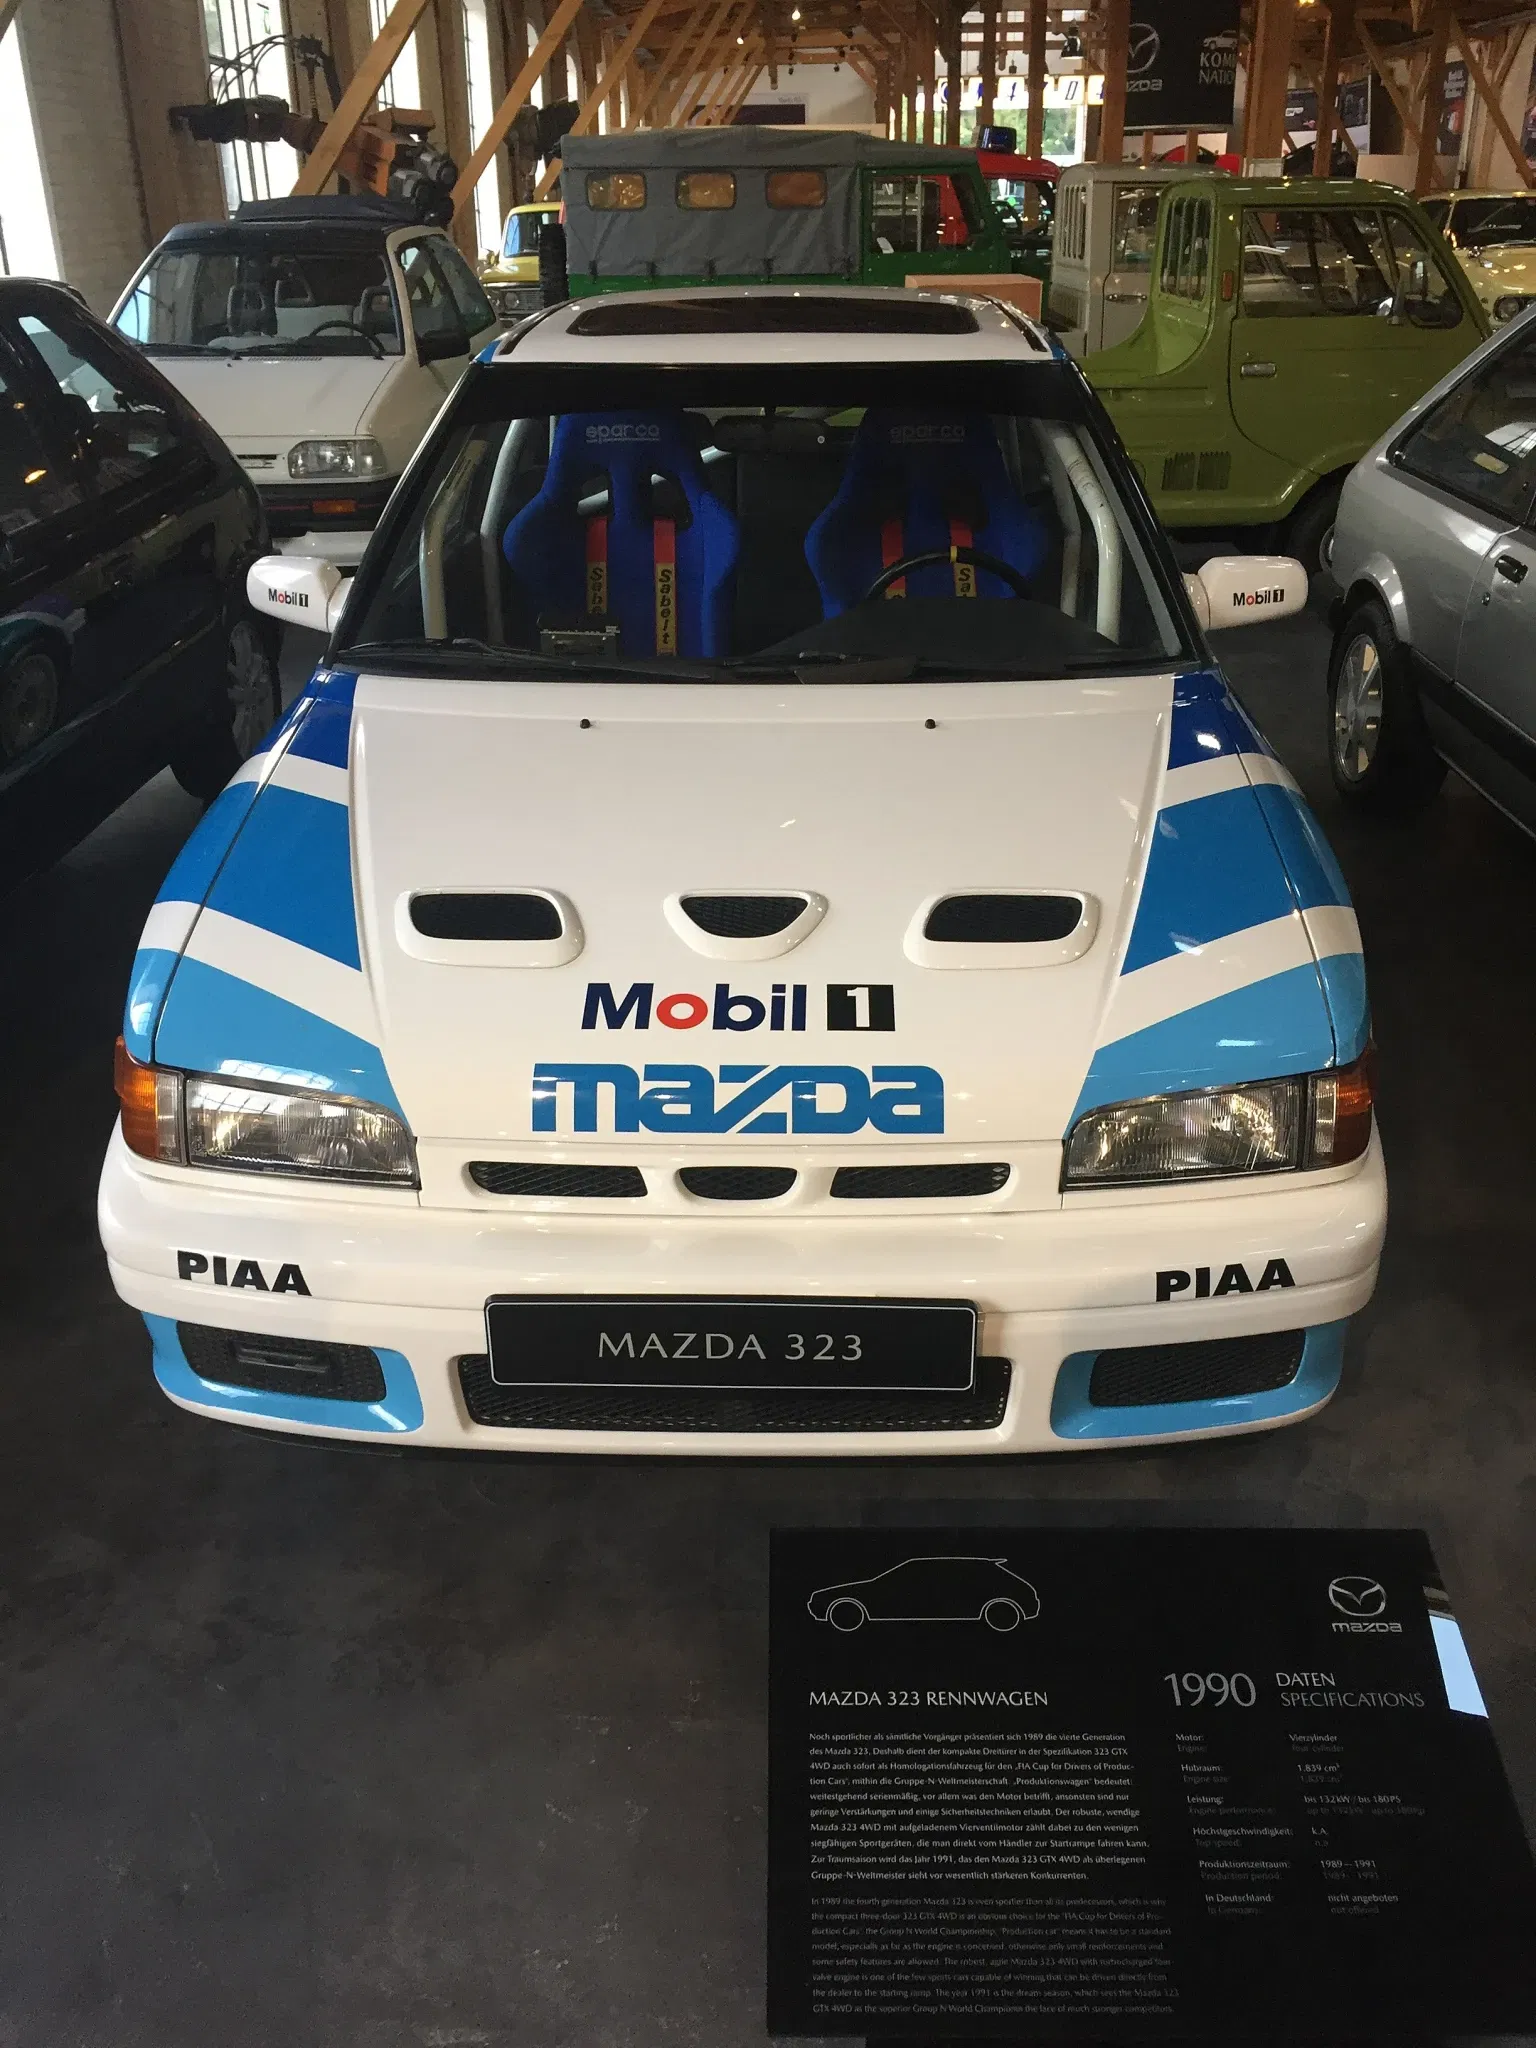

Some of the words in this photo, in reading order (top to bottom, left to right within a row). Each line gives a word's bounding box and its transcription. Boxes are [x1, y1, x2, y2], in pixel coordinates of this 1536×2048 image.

[585, 424, 660, 442] sparco
[889, 425, 965, 443] sparco
[268, 588, 297, 606] Mobil
[299, 594, 309, 607] 1
[1233, 590, 1271, 606] Mobil
[1273, 589, 1284, 602] 1
[658, 569, 673, 645] Sabelt
[581, 982, 807, 1032] Mobil
[826, 984, 896, 1032] 1
[177, 1250, 312, 1296] PIAA
[1155, 1257, 1297, 1302] PIAA
[598, 1332, 766, 1359] MAZDA
[785, 1333, 861, 1360] 323
[1275, 1672, 1335, 1686] DATEN
[1164, 1672, 1256, 1706] 1990
[809, 1691, 881, 1705] MAZDA
[887, 1691, 919, 1705] 323
[926, 1691, 1047, 1705] RENNWAGEN
[1280, 1692, 1424, 1707] SPECIFICATIONS
[831, 1733, 871, 1741] sportlicher
[873, 1732, 884, 1740] als
[885, 1732, 921, 1740] sämtliche
[922, 1733, 961, 1742] Vorgänger
[963, 1732, 1004, 1742] präsentiert
[1023, 1732, 1043, 1740] 1989
[1081, 1732, 1125, 1741] Generation
[809, 1747, 823, 1755] des
[824, 1747, 851, 1755] Mazda
[872, 1747, 904, 1755] Deshalb
[906, 1747, 925, 1755] dient
[927, 1747, 940, 1755] der
[942, 1747, 981, 1756] kompakte
[982, 1747, 1017, 1755] Dreitürer
[1018, 1747, 1026, 1755] in
[1027, 1747, 1040, 1755] der
[1042, 1747, 1092, 1756] Spezifikation
[1094, 1747, 1109, 1755] 323
[1111, 1747, 1127, 1755] GTX
[809, 1761, 830, 1769] 4WD
[832, 1762, 851, 1770] auch
[984, 1761, 995, 1770] für
[997, 1762, 1012, 1770] den
[1032, 1762, 1049, 1771] Cup
[1064, 1762, 1091, 1770] Drivers
[1093, 1762, 1101, 1770] of
[879, 1777, 892, 1785] die
[809, 1792, 867, 1802] weitestgehend
[869, 1791, 920, 1802] serienmäßig,
[937, 1792, 959, 1800] allem
[978, 1792, 994, 1800] den
[996, 1792, 1021, 1800] Motor
[1097, 1792, 1114, 1800] sind
[810, 1807, 839, 1817] geringe
[840, 1807, 896, 1818] Verstärkungen
[897, 1807, 913, 1815] und
[915, 1808, 939, 1817] einige
[1055, 1807, 1070, 1815] Der
[1072, 1808, 1104, 1816] robuste,
[1105, 1808, 1139, 1818] wendige
[810, 1823, 838, 1831] Mazda
[841, 1823, 856, 1831] 323
[859, 1823, 881, 1831] 4WD
[899, 1822, 957, 1833] aufgeladenem
[1025, 1823, 1045, 1831] zählt
[1047, 1823, 1071, 1831] dabei
[1085, 1823, 1101, 1831] den
[1103, 1825, 1138, 1833] wenigen
[810, 1838, 856, 1849] siegfähigen
[859, 1838, 914, 1848] Sportgeräten,
[916, 1838, 929, 1847] die
[952, 1839, 976, 1847] direkt
[998, 1839, 1032, 1847] Händler
[1049, 1839, 1095, 1848] Startrampe
[1097, 1838, 1124, 1847] fahren
[810, 1854, 825, 1863] Zur
[827, 1854, 876, 1863] Traumsaison
[878, 1854, 896, 1863] wird
[898, 1855, 912, 1863] das
[914, 1855, 930, 1863] Jahr
[933, 1854, 956, 1863] 1991,
[958, 1854, 972, 1863] das
[973, 1855, 989, 1863] den
[991, 1855, 1019, 1863] Mazda
[1021, 1854, 1037, 1863] 323
[1039, 1855, 1056, 1863] GTX
[1058, 1855, 1080, 1863] 4WD
[1082, 1855, 1093, 1863] als
[1095, 1855, 1145, 1865] überlegenen
[908, 1870, 927, 1879] sieht
[944, 1871, 988, 1879] wesentlich
[990, 1871, 1028, 1879] stärkeren
[1030, 1871, 1088, 1879] Konkurrenten.
